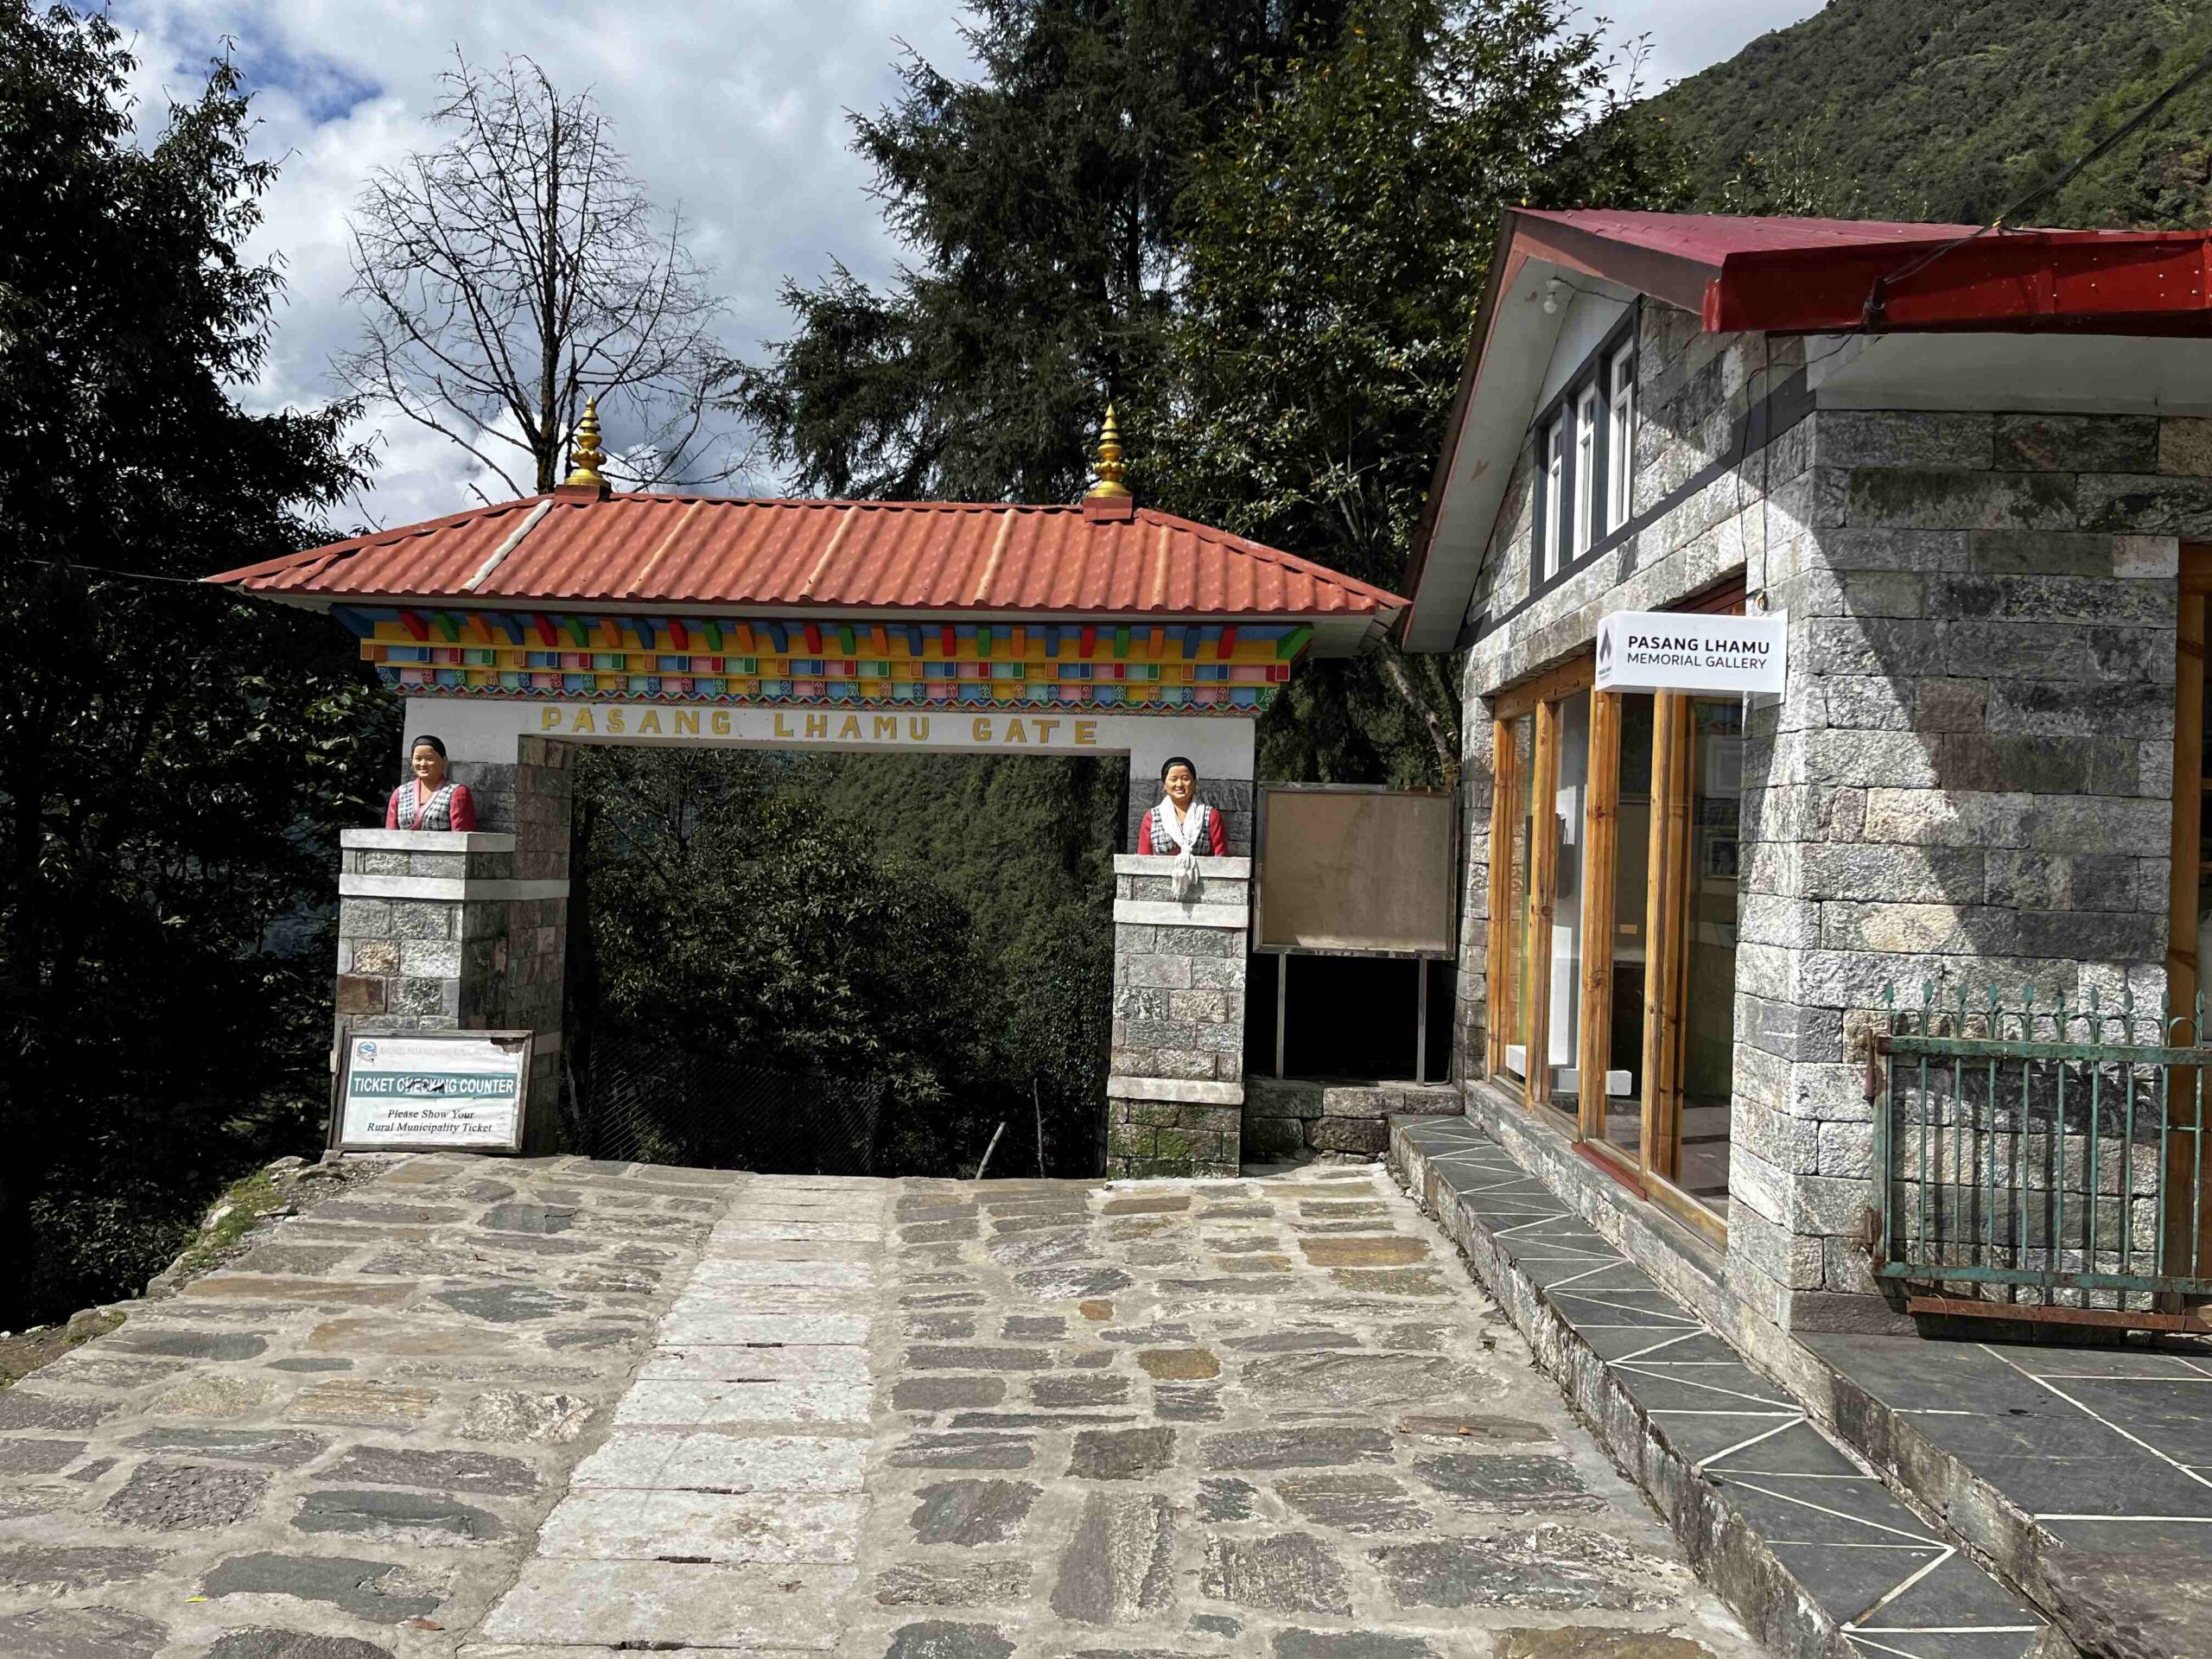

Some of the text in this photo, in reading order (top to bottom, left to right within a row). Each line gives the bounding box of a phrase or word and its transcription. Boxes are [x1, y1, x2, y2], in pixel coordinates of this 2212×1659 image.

[1628, 635, 1770, 655] PASANG LHAMU
[1627, 652, 1767, 670] MEMORIAL GALLERY
[540, 705, 1097, 745] PASANG LHAMU GATE
[353, 1077, 396, 1093] TICKET
[459, 1077, 514, 1094] COUNTER
[387, 1109, 475, 1119] Please Show Your
[366, 1122, 493, 1134] Rural Municipality Ticket
